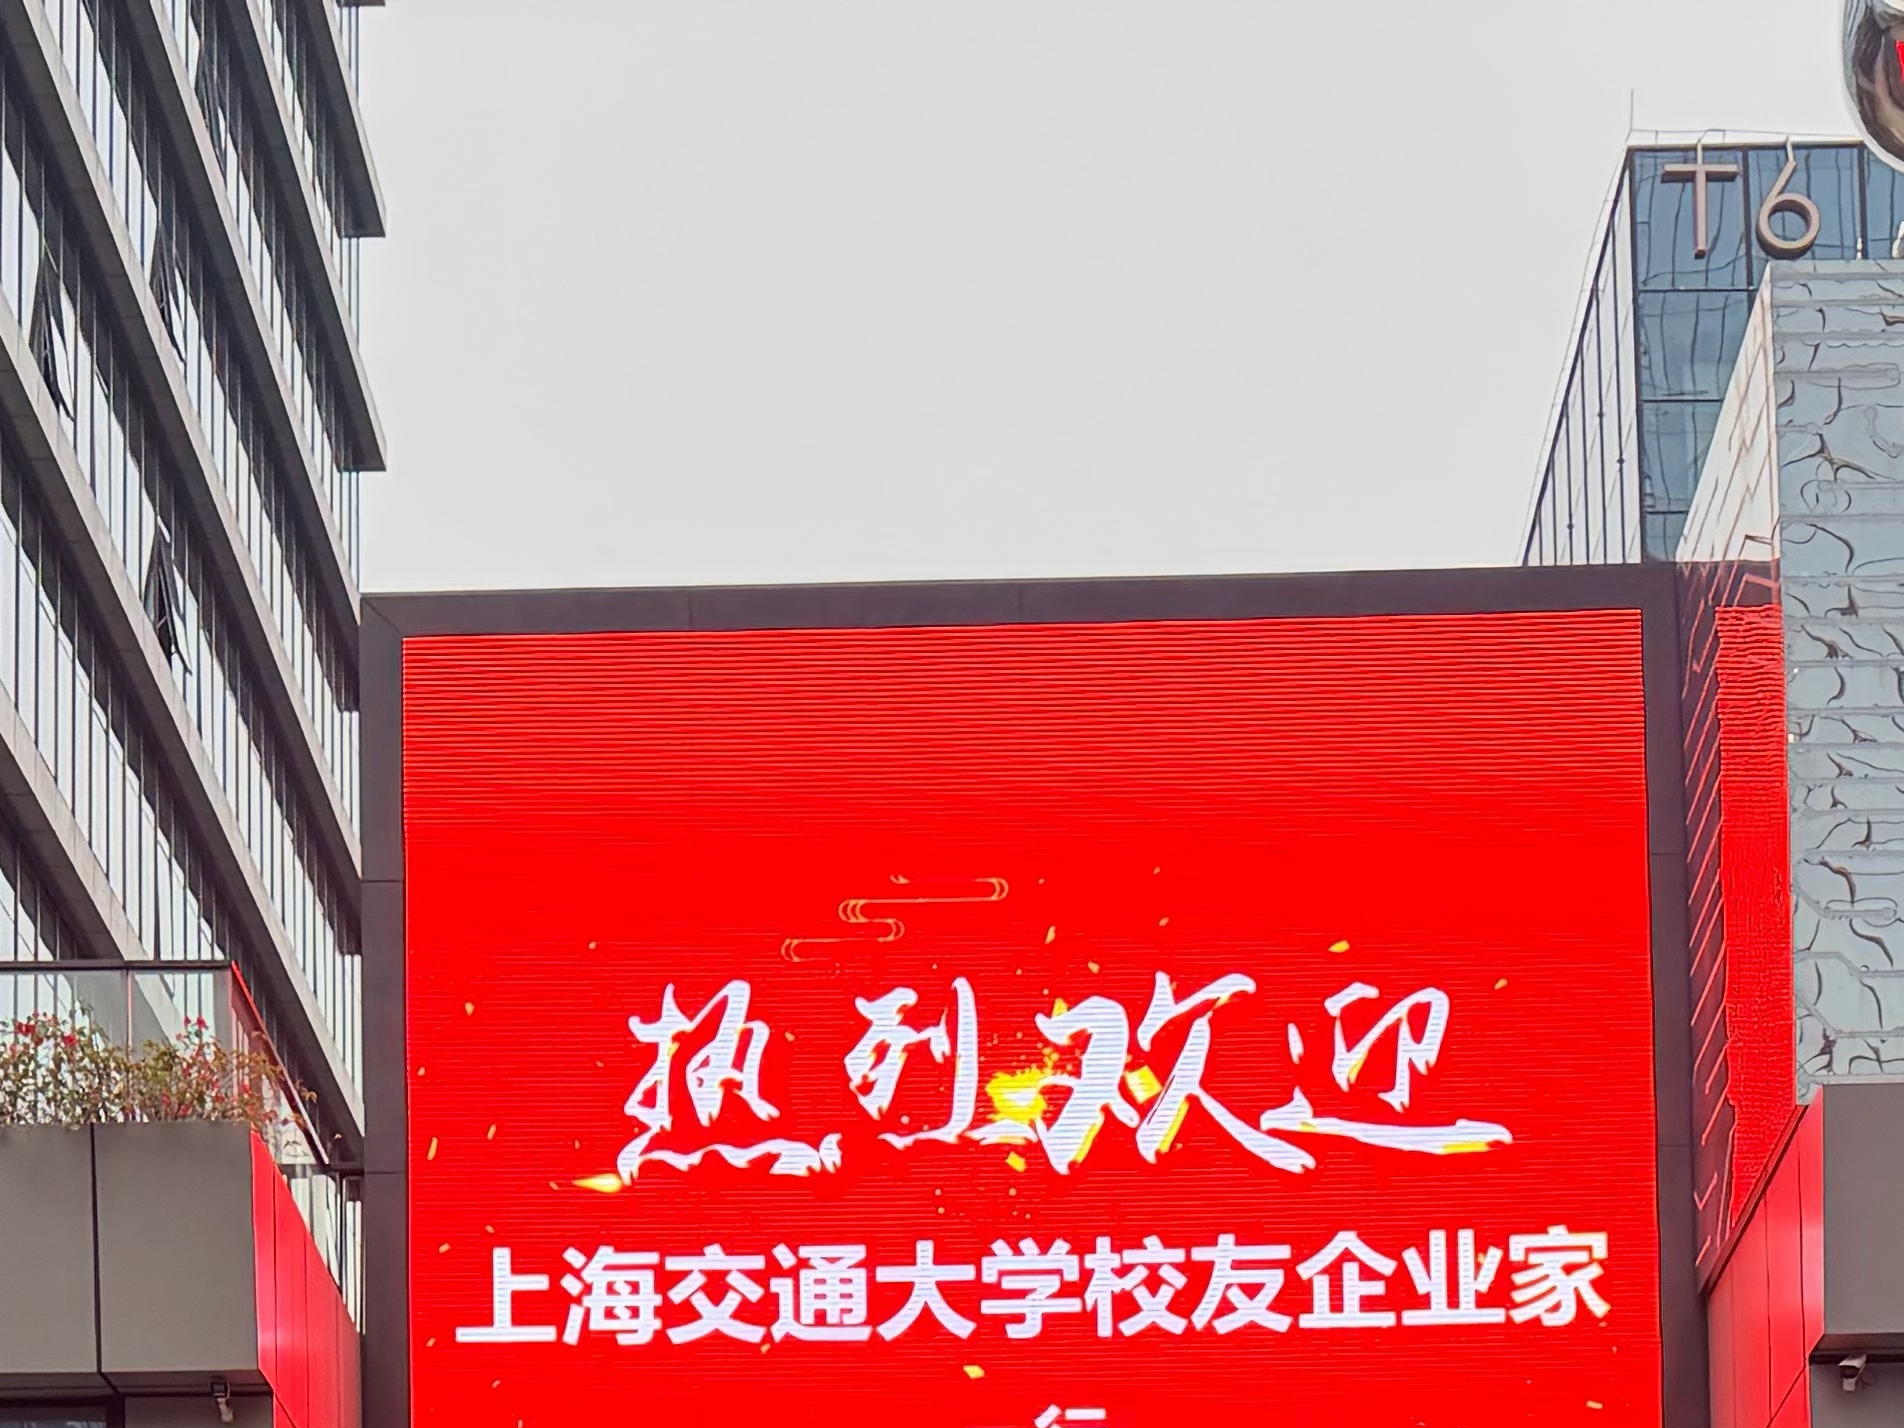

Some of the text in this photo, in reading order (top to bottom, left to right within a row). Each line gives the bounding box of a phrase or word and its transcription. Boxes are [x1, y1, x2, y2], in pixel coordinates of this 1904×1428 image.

[616, 972, 1512, 1180] 热烈欢迎
[455, 1226, 1612, 1347] 上海交通大学校友企业家
